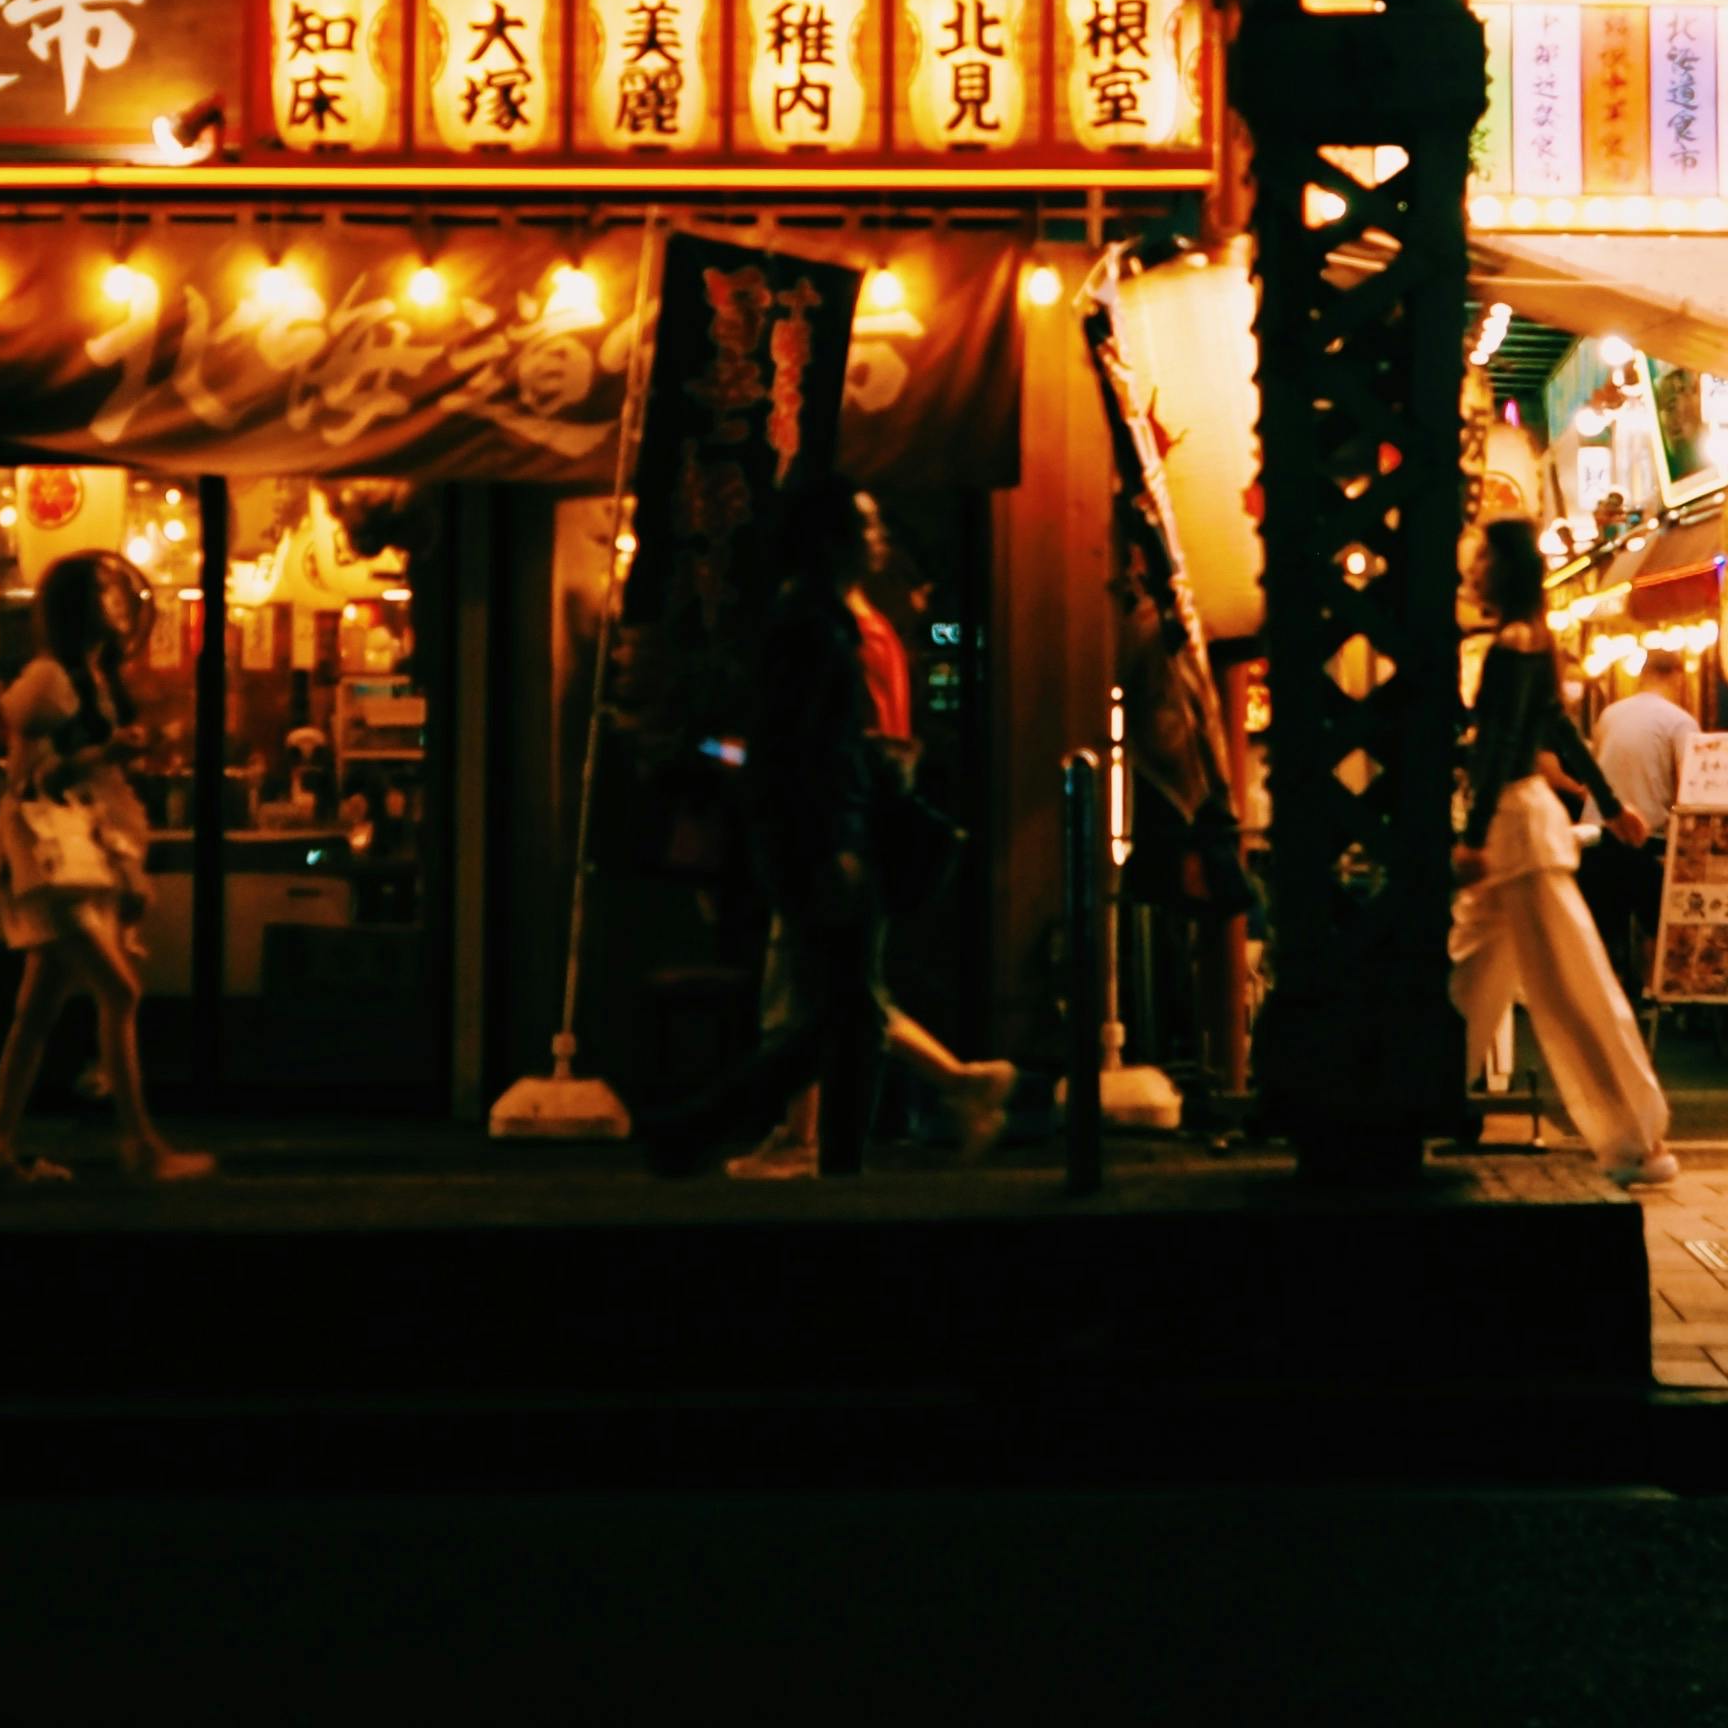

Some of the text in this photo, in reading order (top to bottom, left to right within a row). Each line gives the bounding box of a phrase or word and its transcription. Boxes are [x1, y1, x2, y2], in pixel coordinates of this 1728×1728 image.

[287, 2, 358, 133] 知床
[460, 2, 533, 133] 大塚
[766, 0, 837, 133] 稚内
